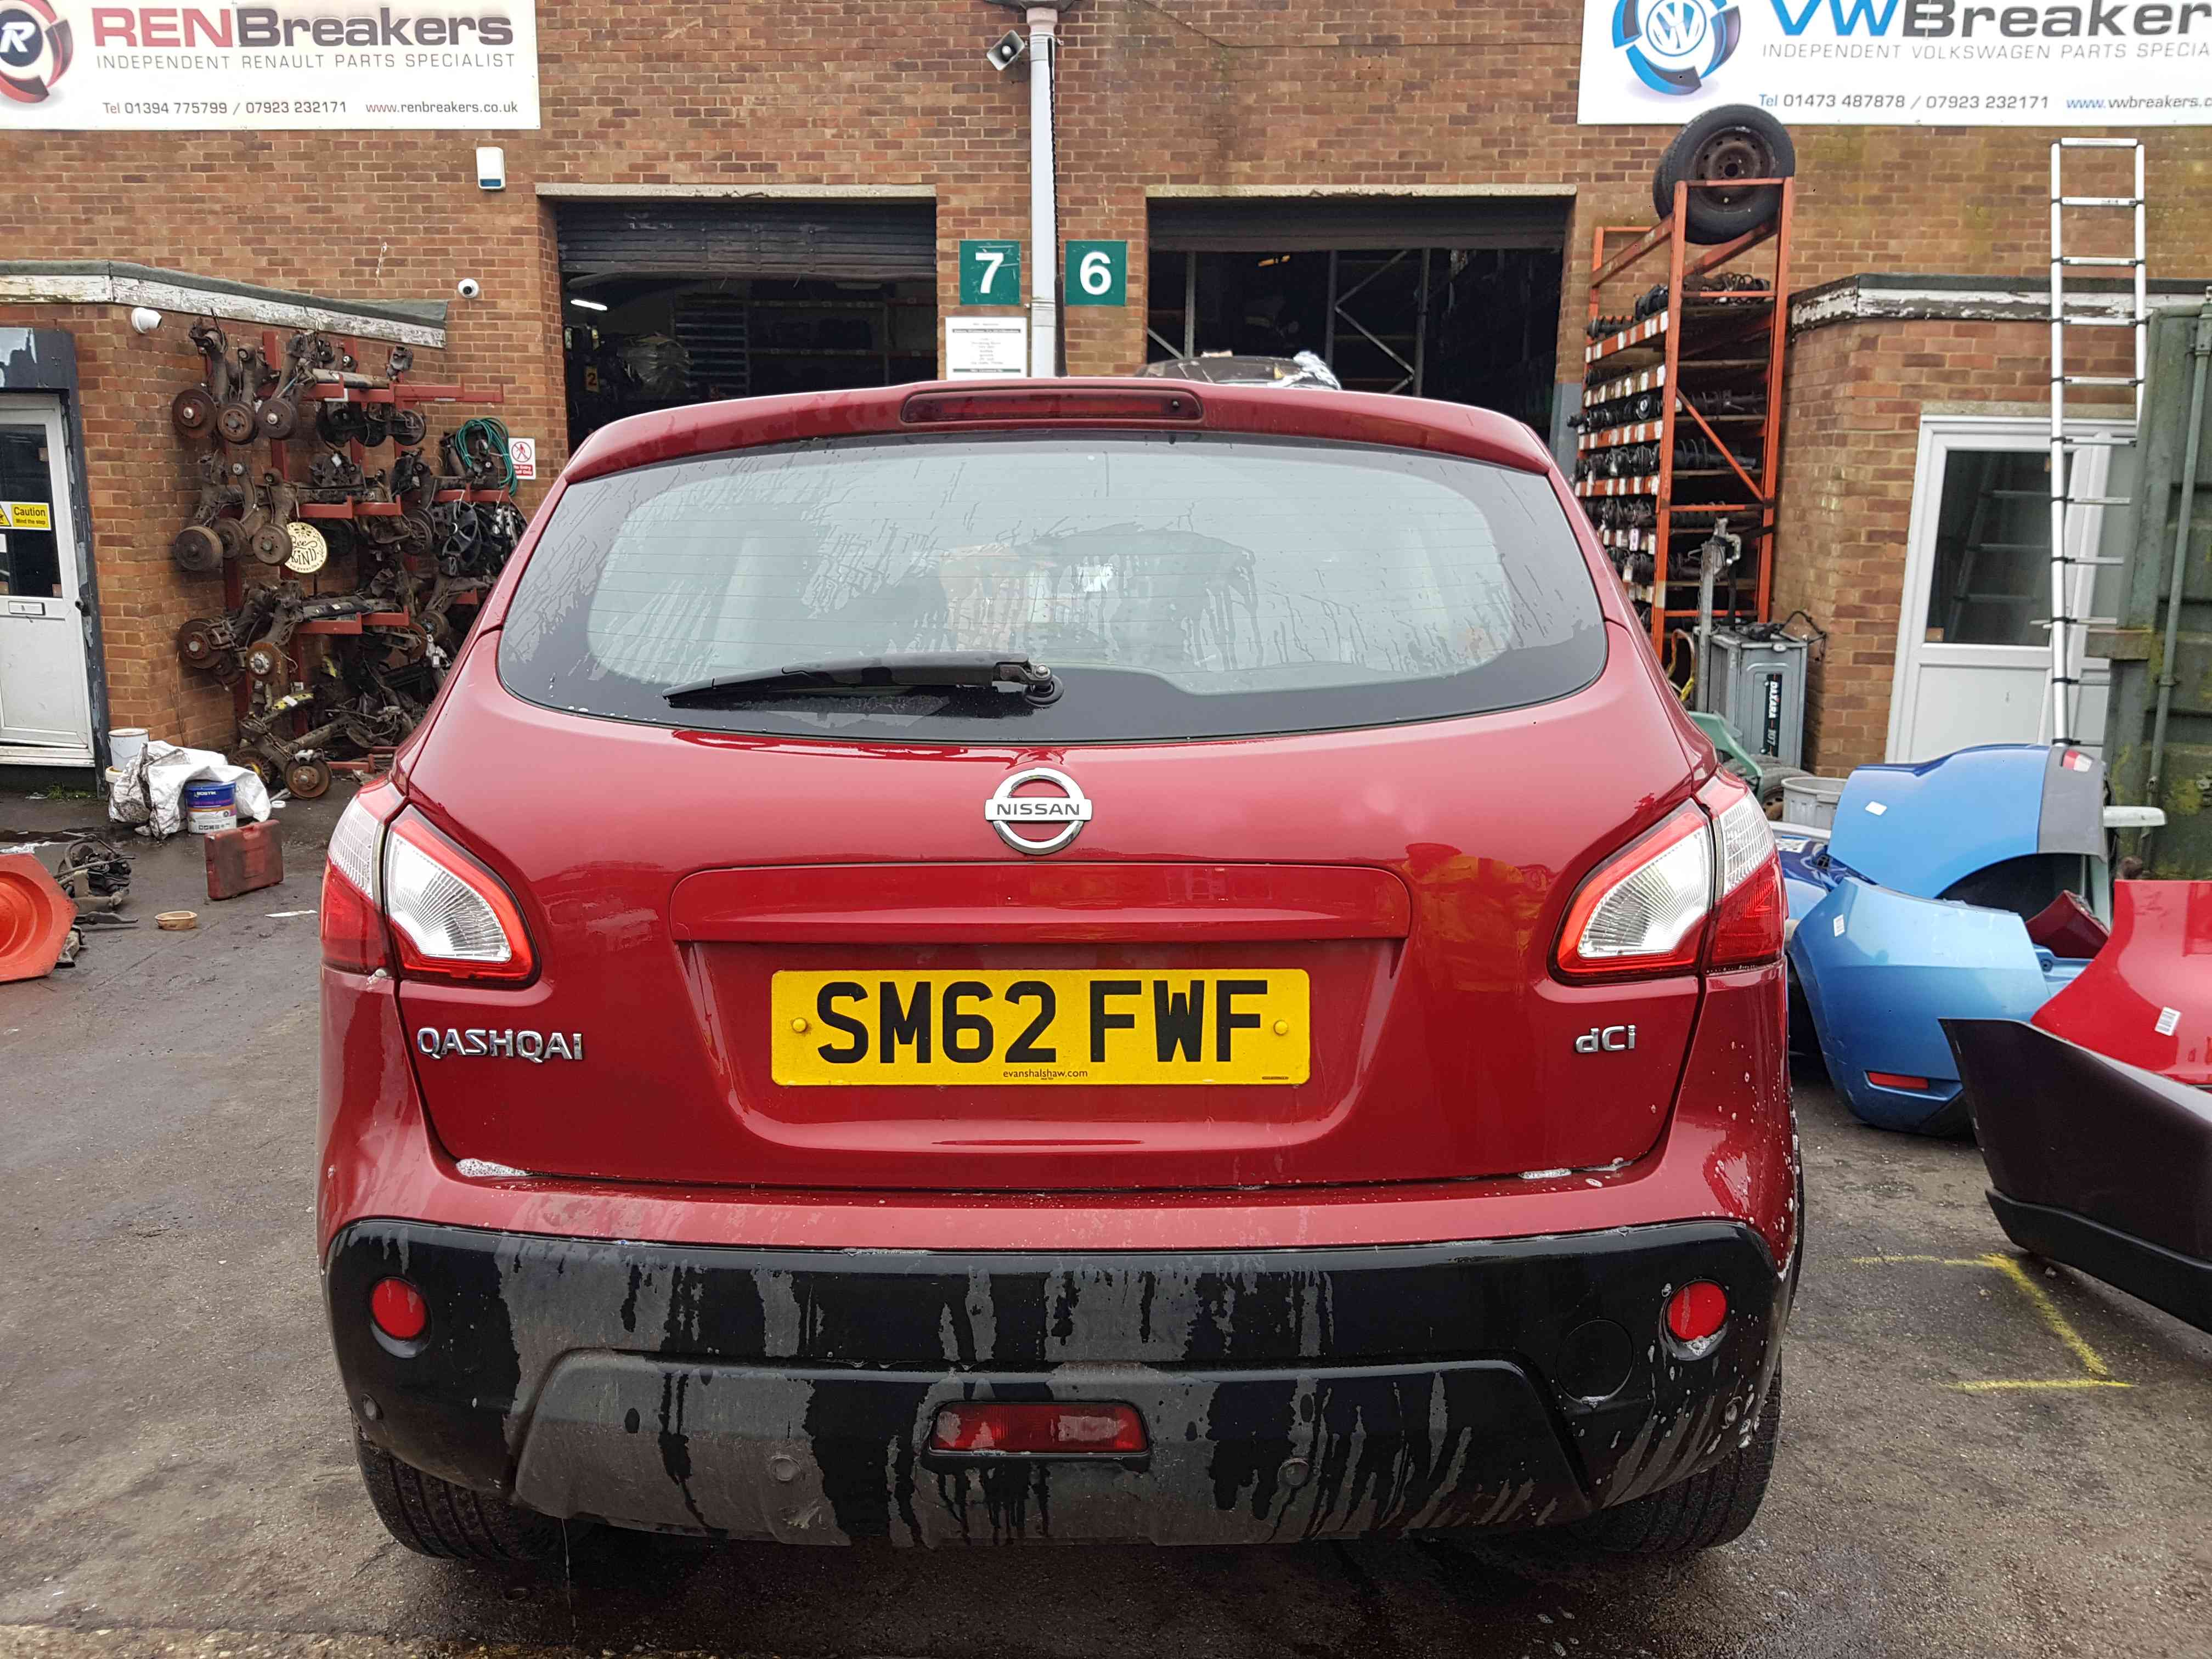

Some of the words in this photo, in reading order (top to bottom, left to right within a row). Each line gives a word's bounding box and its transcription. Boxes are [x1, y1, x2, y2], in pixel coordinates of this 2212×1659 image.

[92, 7, 514, 47] RENBreakers
[1763, 43, 1901, 59] INDEPENDENT
[1912, 44, 2051, 59] VOLKSWAGEN
[2061, 43, 2126, 58] PARTS
[2137, 42, 2210, 58] SPECIA
[97, 55, 230, 69] INDEPENDENT
[242, 55, 324, 69] RENAULT
[335, 54, 395, 67] PARTS
[405, 53, 515, 67] SPECIALIST
[103, 103, 120, 114] Tel
[125, 103, 169, 114] 01394
[176, 103, 227, 114] 775799
[246, 102, 289, 114] 07923
[295, 101, 346, 113] 232171
[365, 101, 518, 113] www.renbreakers.co.uk
[1759, 94, 1778, 106] Tel
[1784, 94, 1836, 108] 01473
[1842, 94, 1905, 108] 487878
[1926, 96, 1979, 109] 07923
[1985, 96, 2049, 109] 232171
[975, 252, 1005, 294] 7
[1080, 251, 1112, 295] 6
[14, 506, 46, 517] Caution
[996, 803, 1080, 816] NISSAN
[816, 980, 1056, 1064] SM62
[1090, 980, 1268, 1063] FWF
[417, 1027, 583, 1063] QASHQAI
[1576, 1025, 1636, 1053] dCi
[1003, 1068, 1088, 1077] evanshalshaw.com
